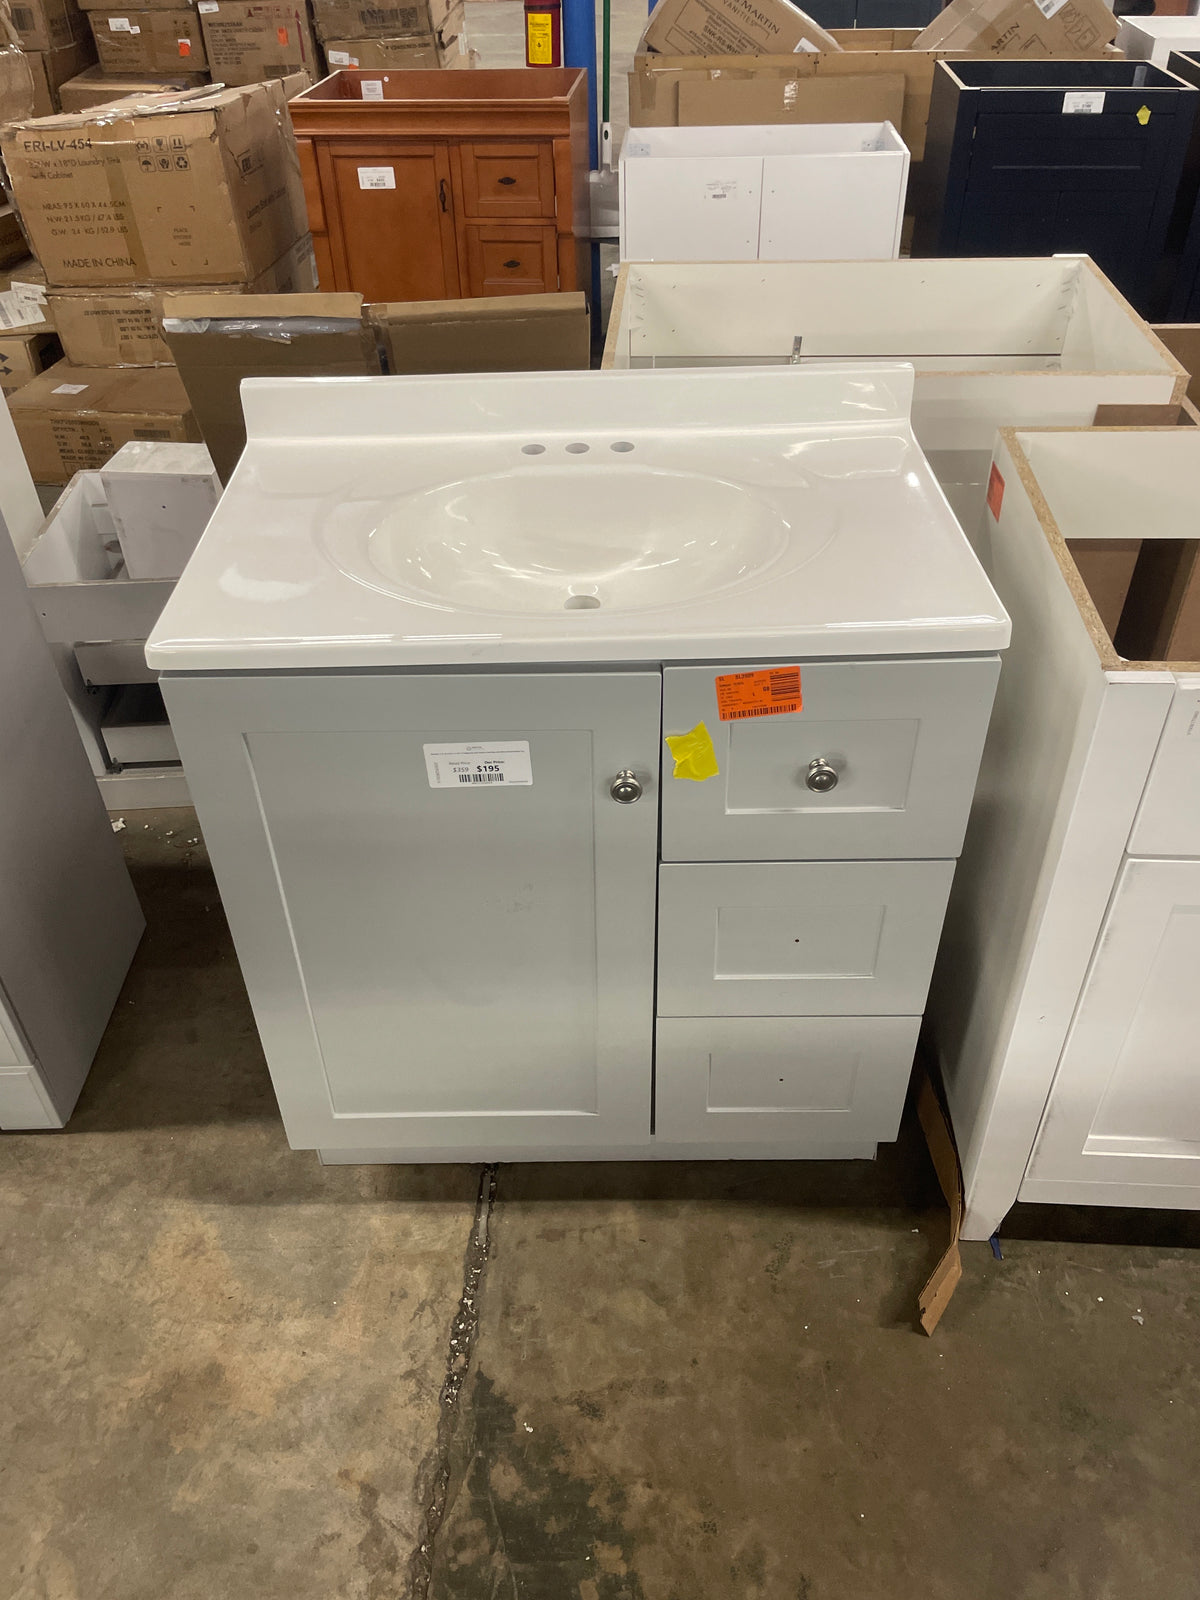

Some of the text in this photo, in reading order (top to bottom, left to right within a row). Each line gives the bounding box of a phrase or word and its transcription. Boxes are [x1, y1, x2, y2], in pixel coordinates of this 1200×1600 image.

[740, 0, 780, 34] MARTIN
[23, 137, 93, 153] ERI-LV-454
[62, 256, 137, 268] MADE IN CHINA
[476, 764, 500, 773] $195
